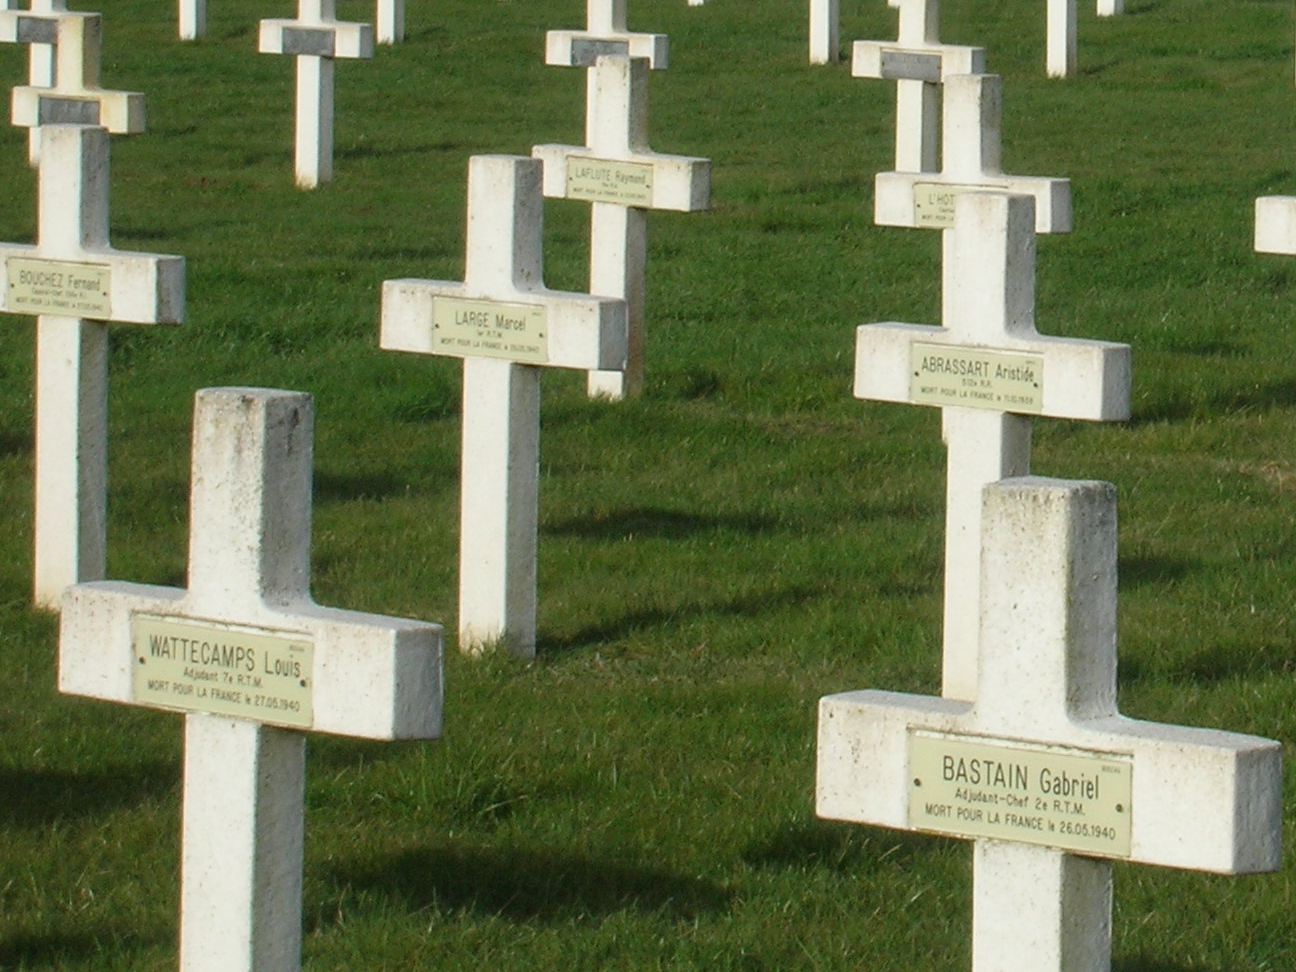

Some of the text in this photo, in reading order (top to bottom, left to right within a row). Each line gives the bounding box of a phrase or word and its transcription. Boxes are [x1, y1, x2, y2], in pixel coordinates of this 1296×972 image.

[20, 270, 101, 291] BOUCHEZ Fernand
[455, 310, 526, 331] LARGE Marcel
[922, 355, 1034, 383] ABRASSART Aristide
[921, 386, 938, 394] MORT
[940, 387, 957, 397] POUR
[959, 390, 968, 398] LA
[969, 391, 994, 401] FRANCE
[150, 634, 301, 678] WATTECAMPS Louis
[184, 666, 219, 682] Adjudant
[237, 674, 263, 688] R.T.M.
[147, 679, 170, 691] MORT
[172, 682, 194, 695] POUR
[197, 686, 208, 697] LA
[211, 688, 241, 704] FRANCE
[943, 755, 1099, 800] BASTAIN Gabriel
[955, 787, 1086, 816] Adjudant-Chef 2e R.T.M.
[924, 802, 1116, 841] MORT POUR LA FRANCE le 26.05.1940
